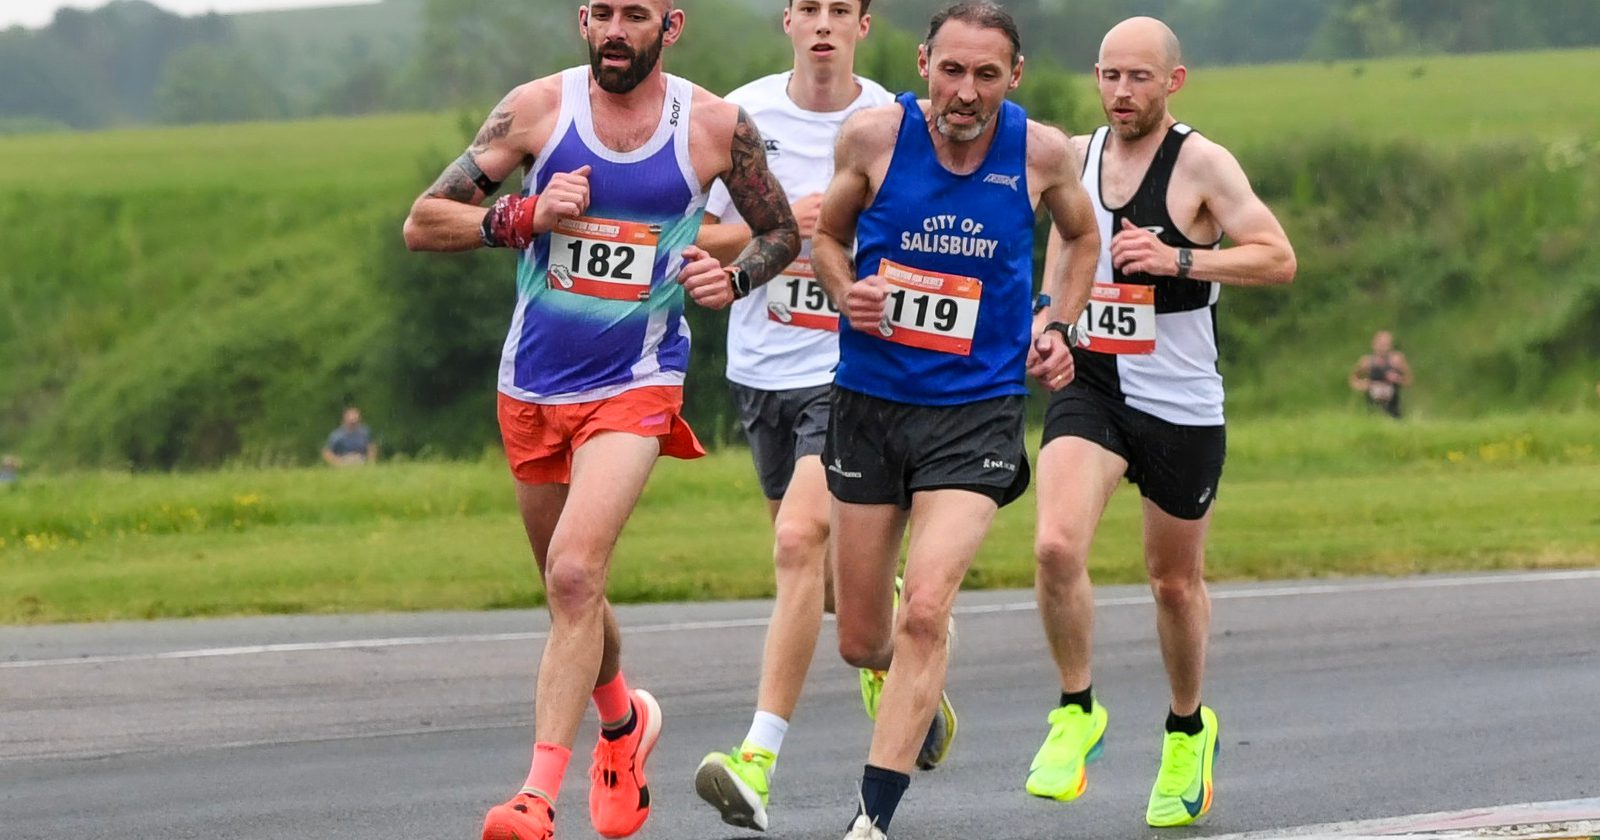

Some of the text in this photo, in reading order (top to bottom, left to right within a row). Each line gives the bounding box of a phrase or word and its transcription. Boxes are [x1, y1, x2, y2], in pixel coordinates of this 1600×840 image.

[669, 97, 682, 127] soar
[922, 214, 985, 236] CITY OF
[567, 239, 635, 281] 182
[900, 230, 999, 259] SALISBURY
[890, 289, 959, 332] 119
[1086, 302, 1137, 337] 145
